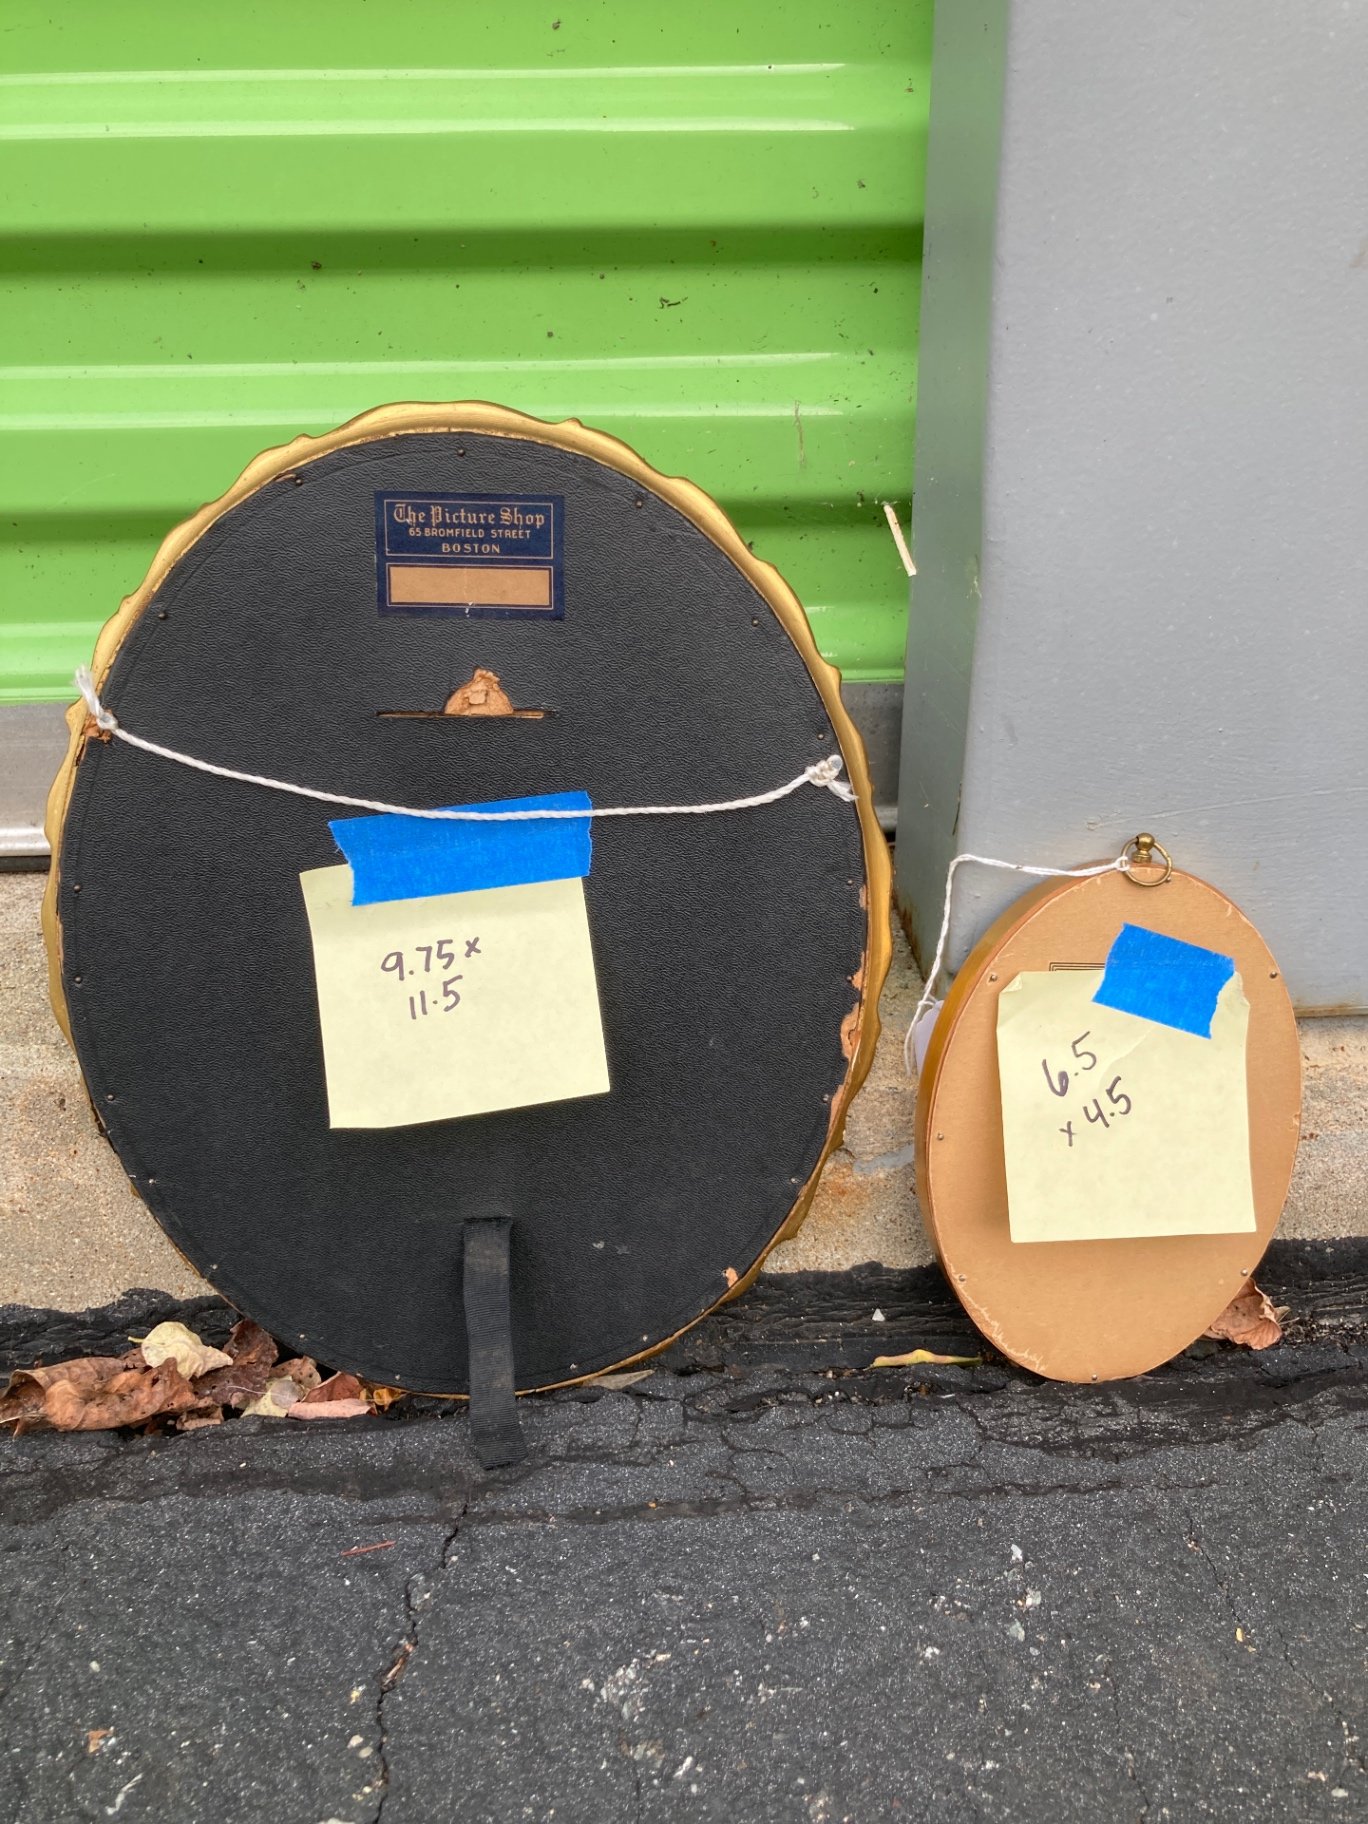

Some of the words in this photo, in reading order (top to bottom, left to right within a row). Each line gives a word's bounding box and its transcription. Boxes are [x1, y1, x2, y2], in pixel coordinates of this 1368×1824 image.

[393, 503, 426, 527] The
[430, 505, 496, 527] Picture
[499, 507, 545, 529] Shop
[408, 527, 422, 537] 65
[425, 527, 485, 538] BROMFIELD
[490, 529, 531, 539] STREET
[441, 543, 501, 554] BOSTON
[380, 939, 455, 981] 9.75
[408, 974, 463, 1020] 11.5
[1041, 1031, 1097, 1097] 6.5
[1082, 1075, 1132, 1128] 4.5
